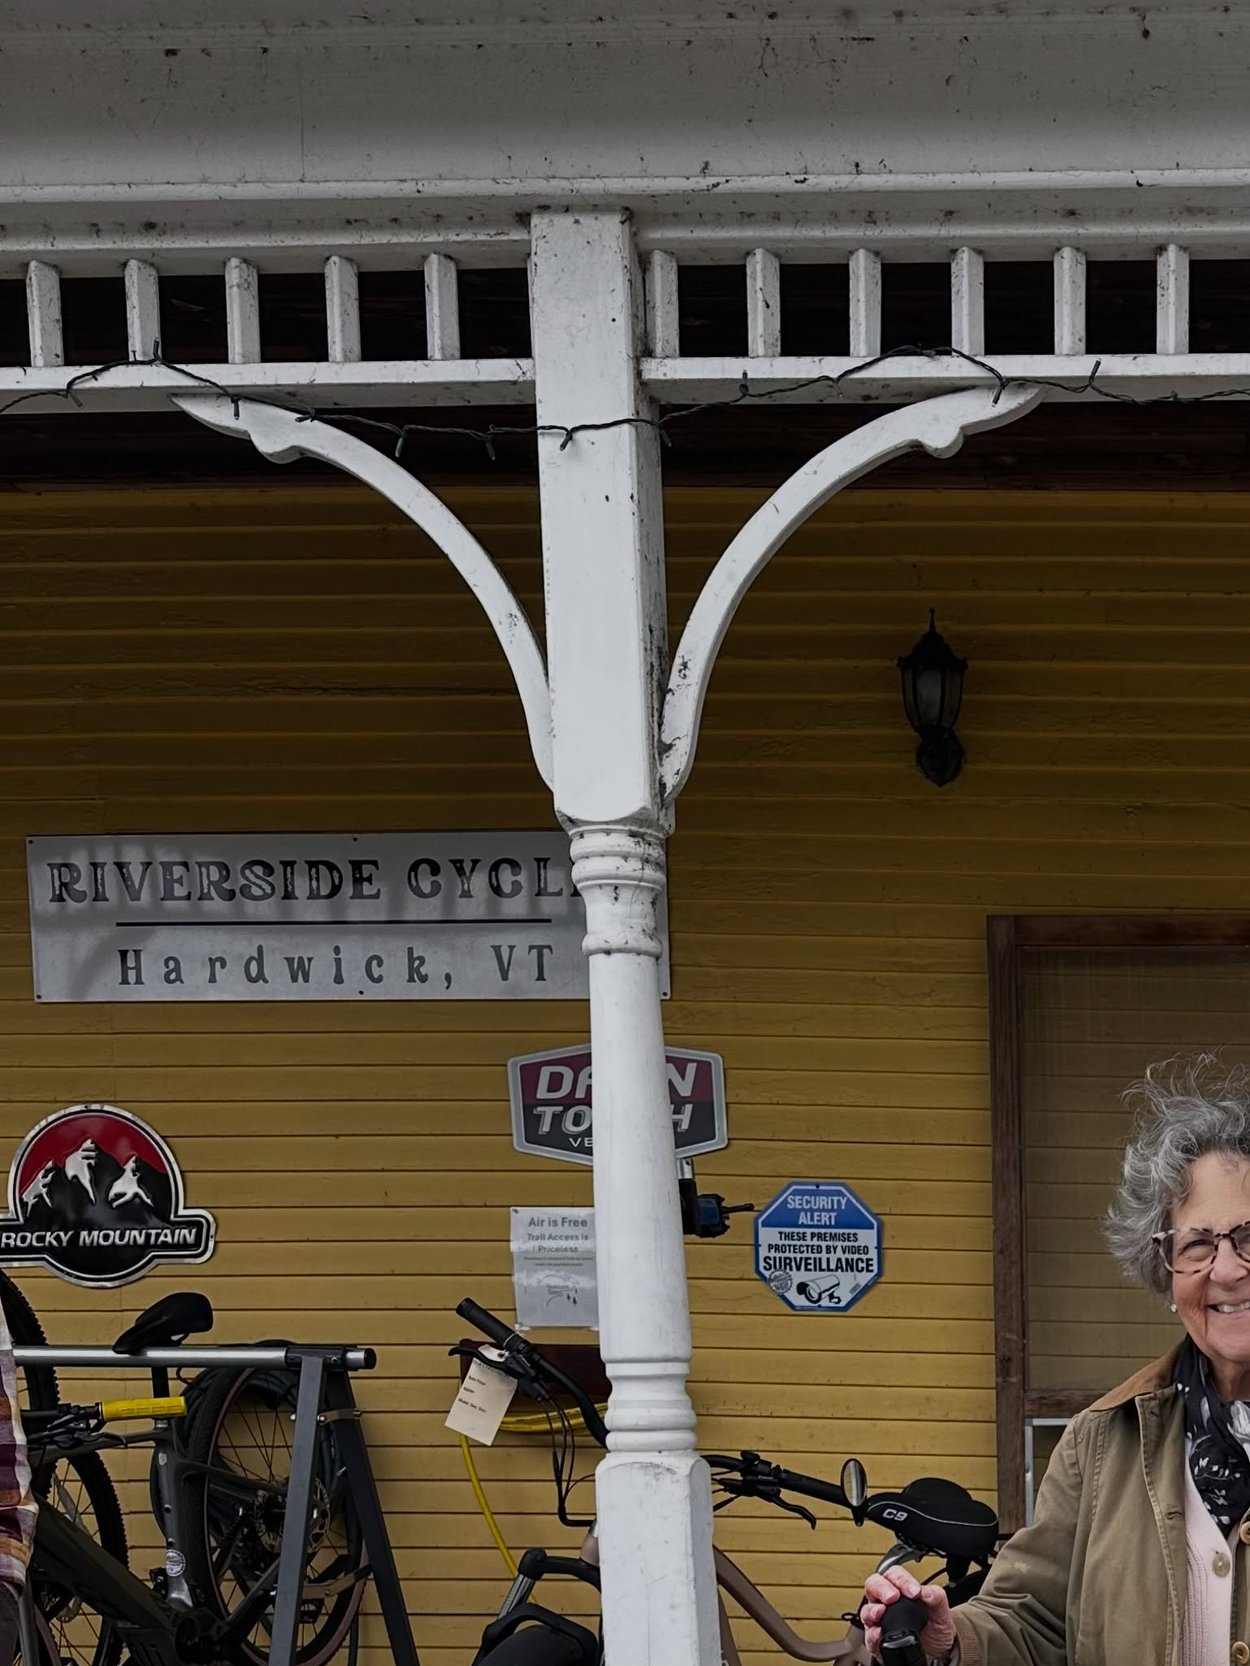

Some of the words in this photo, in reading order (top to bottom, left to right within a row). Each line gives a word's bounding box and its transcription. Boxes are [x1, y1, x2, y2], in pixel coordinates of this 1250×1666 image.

[47, 858, 381, 903] RIVERSIDE
[407, 857, 583, 899] CYCL
[118, 943, 452, 990] Hardwick,
[490, 944, 553, 982] VT
[533, 1103, 693, 1135] TOH
[787, 1195, 848, 1210] SECURITY
[528, 1217, 545, 1228] Air
[548, 1217, 558, 1228] is
[561, 1217, 588, 1228] Free
[798, 1211, 837, 1226] ALERT
[1, 1230, 75, 1248] ROCKY
[79, 1227, 197, 1247] MOUNTAIN
[778, 1231, 807, 1242] THESE
[810, 1232, 859, 1243] PREMISES
[768, 1244, 822, 1255] PROTECTED
[825, 1245, 838, 1255] BY
[841, 1245, 869, 1256] VIDEO
[763, 1256, 874, 1273] SURVEILLANCE
[882, 1508, 909, 1522] C9
